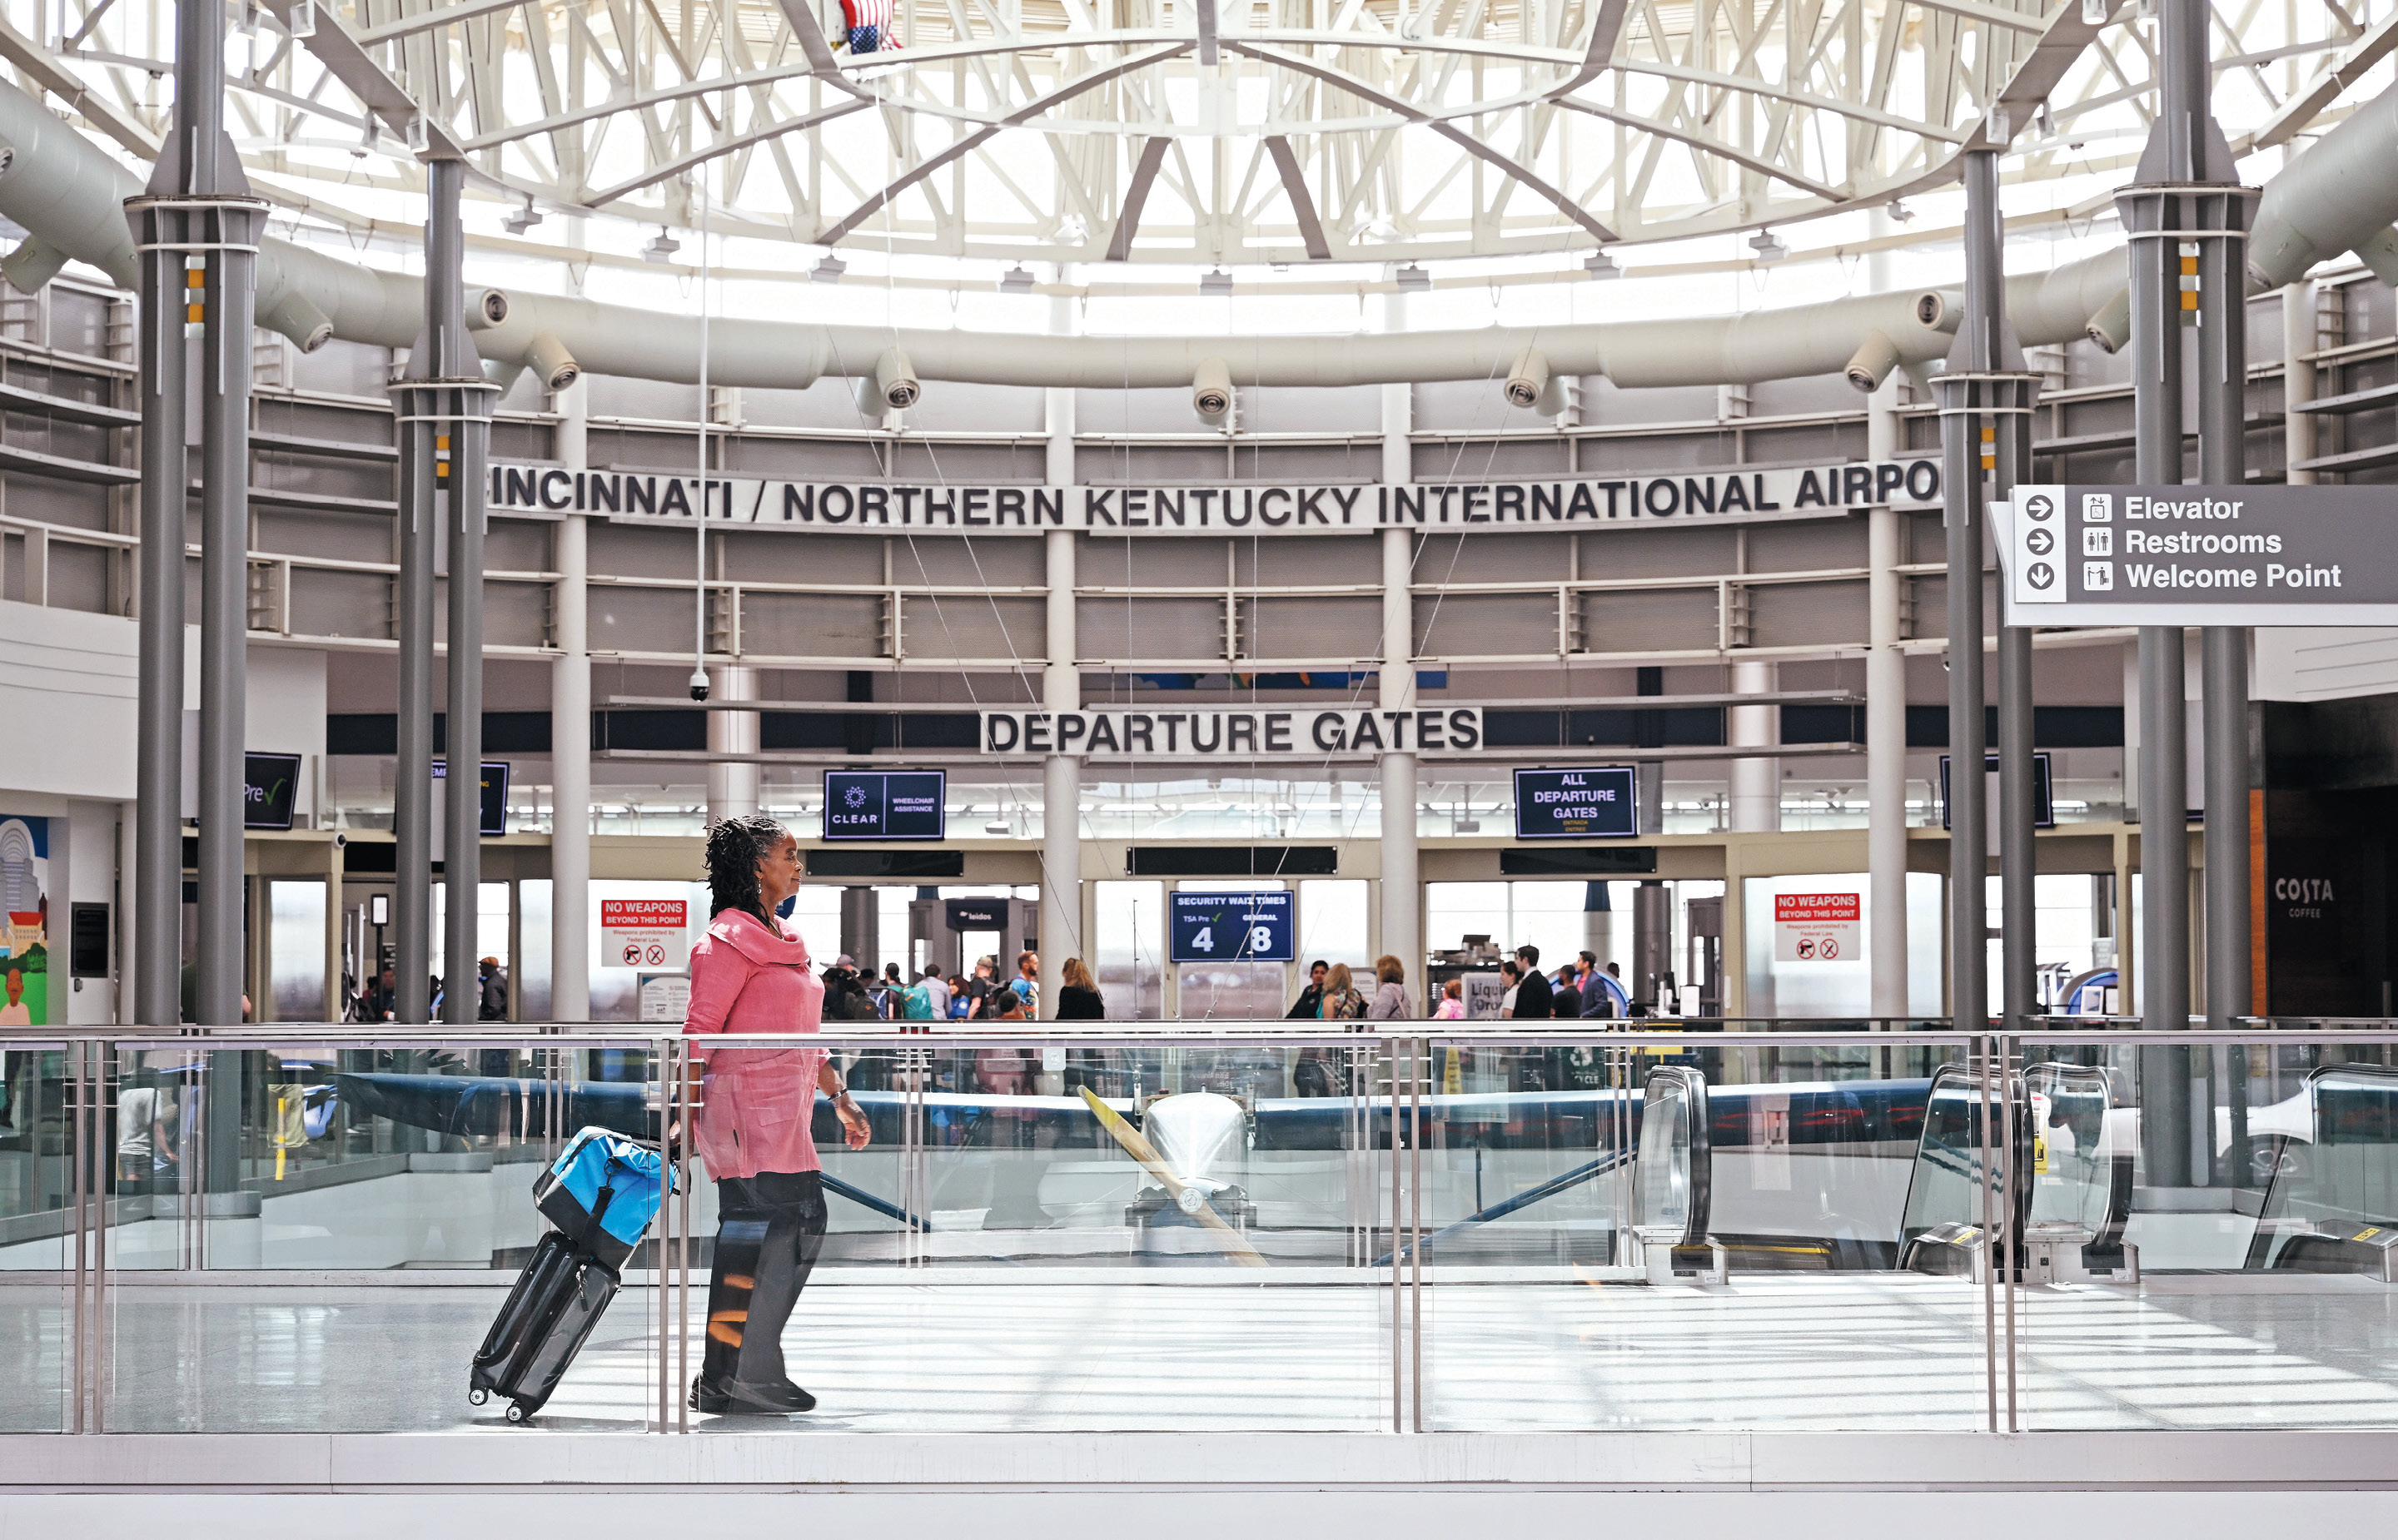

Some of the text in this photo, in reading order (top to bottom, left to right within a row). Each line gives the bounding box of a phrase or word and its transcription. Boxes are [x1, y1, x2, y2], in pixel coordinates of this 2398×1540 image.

[487, 460, 1938, 526] INCINNATI / NORTHERN KENTUCKY INTERNATIONAL AIRPO
[2125, 497, 2244, 519] Elevator
[2125, 530, 2282, 554] Restrooms
[2125, 564, 2342, 589] Welcome Point
[988, 709, 1480, 753] DEPARTURE GATES
[1561, 773, 1587, 786] ALL
[1534, 790, 1616, 803] DEPARTURE
[832, 814, 878, 824] CLEAR
[1553, 807, 1598, 818] GATES
[2275, 877, 2334, 905] COSTA
[605, 902, 683, 913] NO WEAPONS
[1177, 897, 1286, 906] SECURITY WAIT TIMES
[1779, 895, 1856, 907] NO WEAPONS
[1779, 909, 1855, 918] BEYOND THIS POINT
[2288, 908, 2321, 918] COFFEE
[605, 916, 683, 924] BEYOND THIS POINT
[1192, 926, 1215, 952] 4
[1251, 926, 1272, 952] 8
[1476, 999, 1503, 1011] Dro
